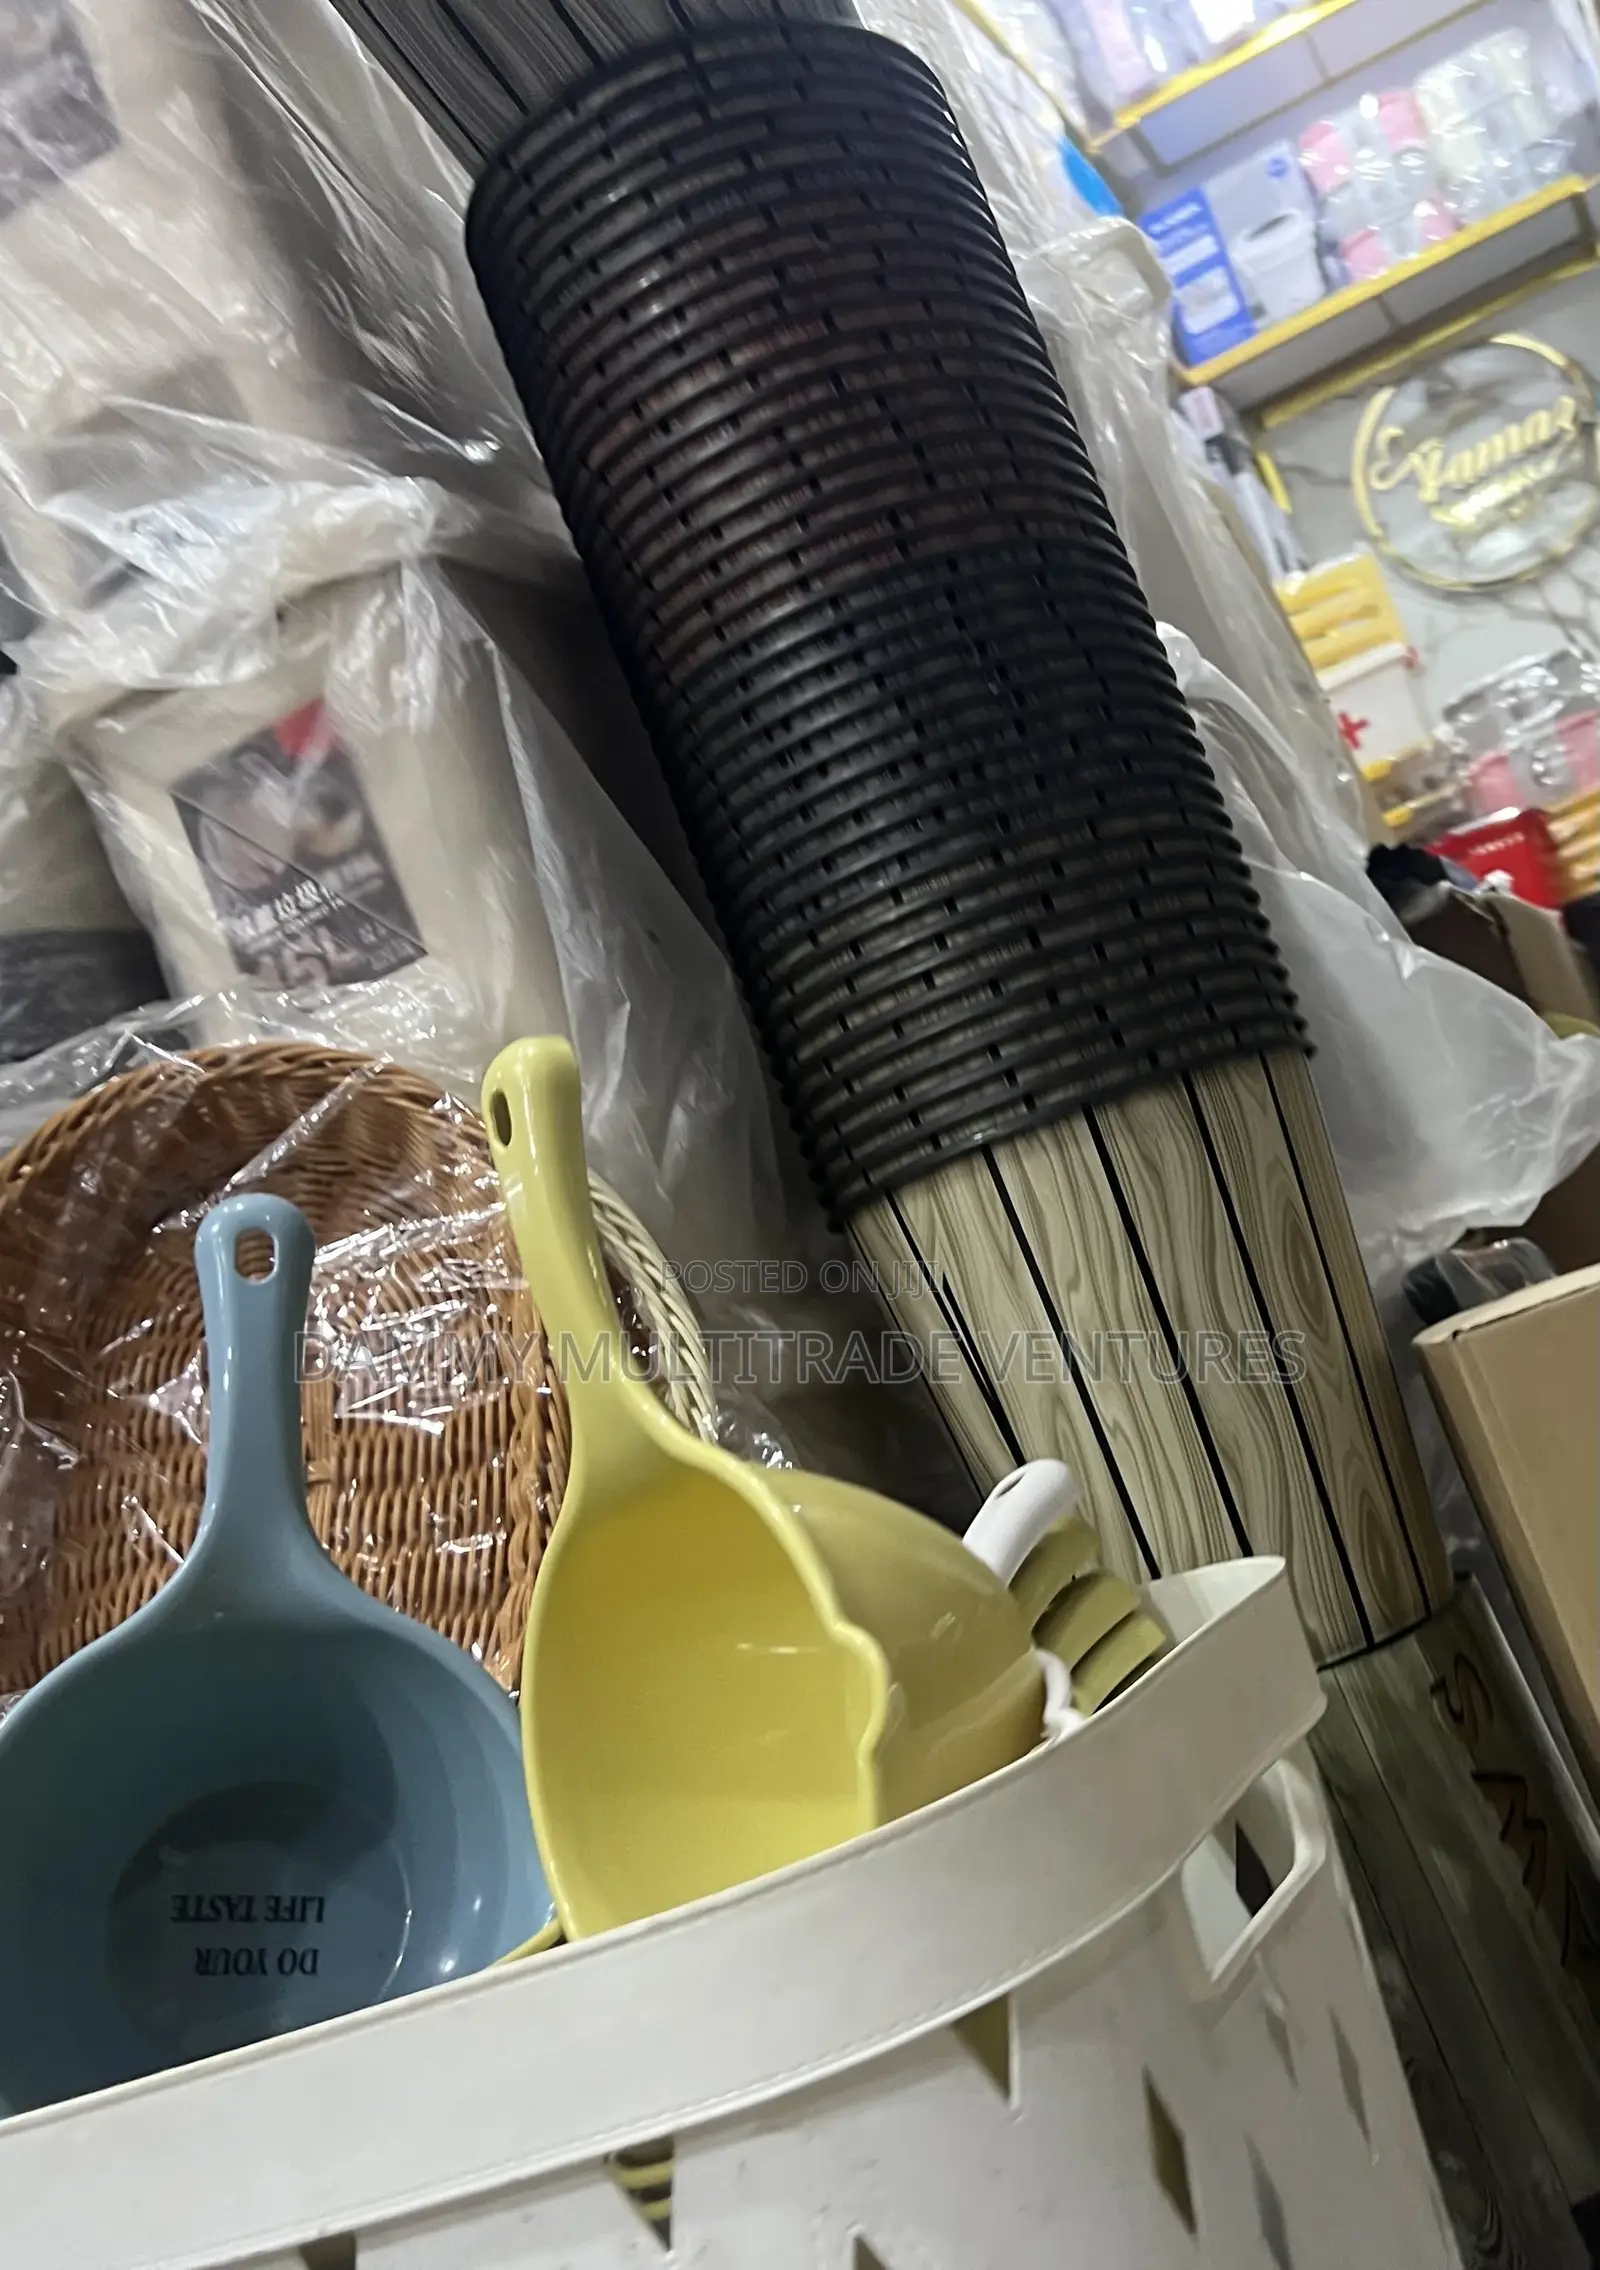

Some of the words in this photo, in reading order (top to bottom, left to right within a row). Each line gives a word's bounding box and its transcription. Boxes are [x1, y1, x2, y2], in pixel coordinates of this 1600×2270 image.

[169, 1894, 258, 1923] TASTE
[264, 1894, 325, 1923] LIFE
[195, 1947, 268, 1976] YOUR
[277, 1947, 319, 1976] DO
